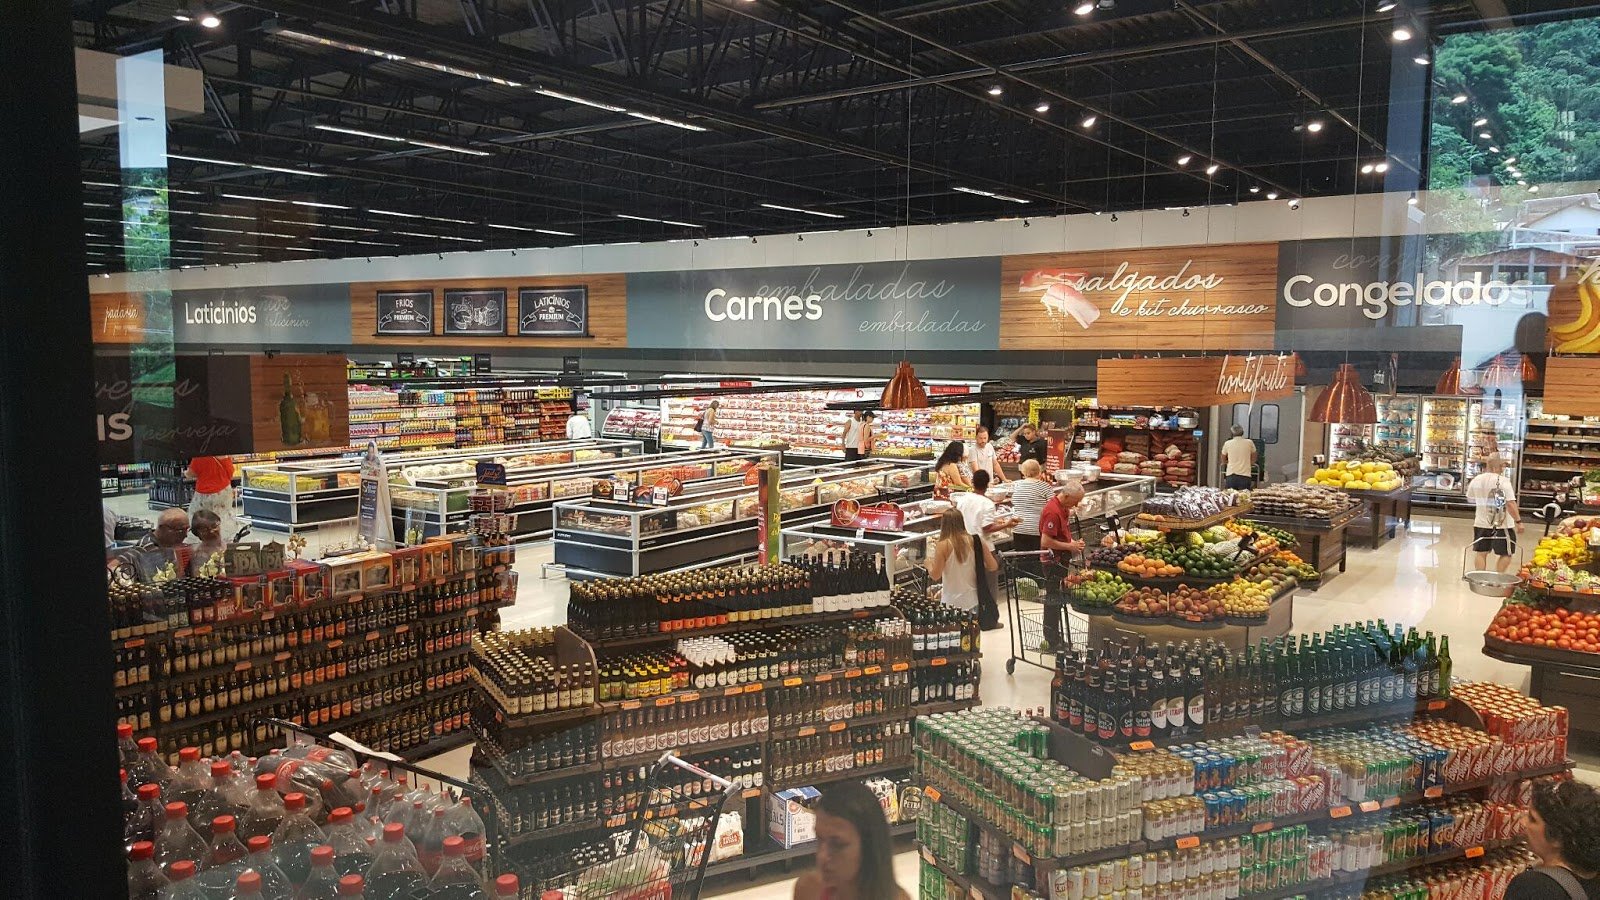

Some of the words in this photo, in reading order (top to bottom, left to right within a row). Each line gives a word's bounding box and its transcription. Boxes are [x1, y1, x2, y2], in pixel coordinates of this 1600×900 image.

[1072, 258, 1224, 315] salgados
[1283, 272, 1534, 320] Congelados
[184, 301, 257, 325] Laticínios
[395, 298, 414, 309] FRIOS
[534, 294, 571, 309] LATICÍNIOS
[704, 288, 823, 322] Carnes
[1119, 306, 1132, 317] e
[1136, 296, 1171, 317] kit
[1168, 298, 1269, 317] churrasco
[538, 312, 564, 321] PREMIUM
[858, 309, 987, 333] embaladas
[1217, 353, 1289, 415] hortifruti
